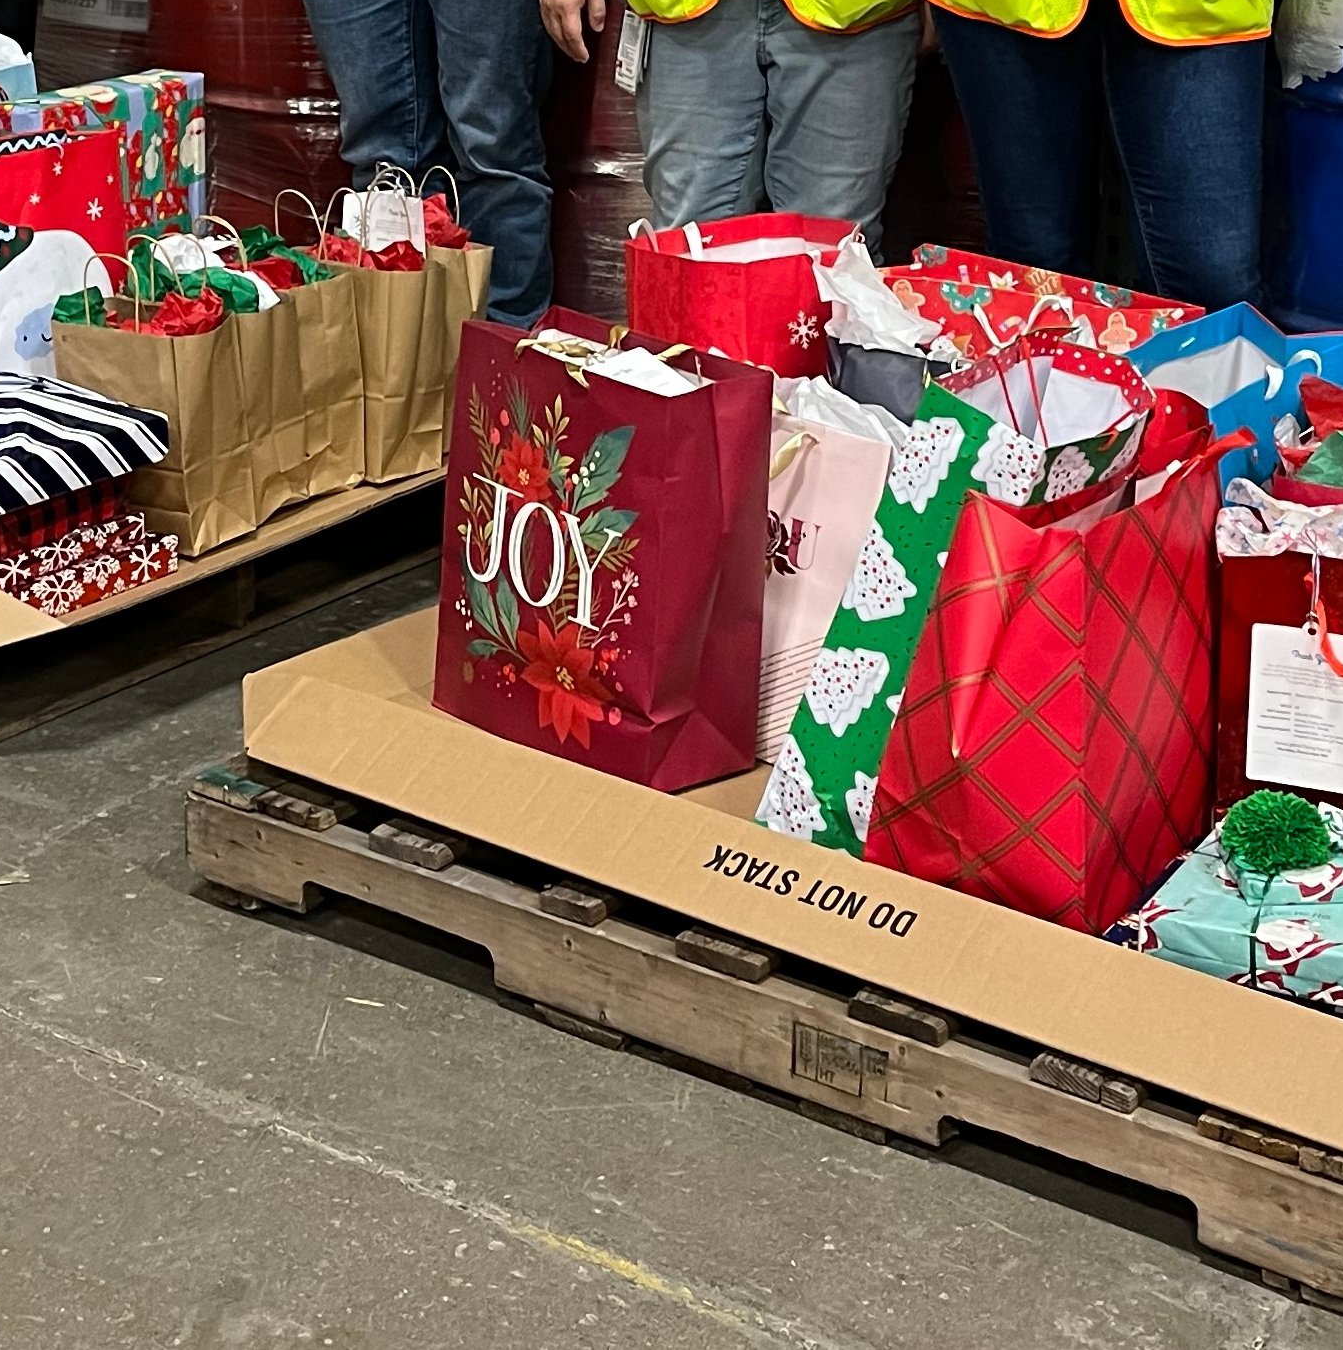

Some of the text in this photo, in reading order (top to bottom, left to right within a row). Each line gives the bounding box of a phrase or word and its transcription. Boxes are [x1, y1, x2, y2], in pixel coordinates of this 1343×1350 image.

[465, 472, 623, 632] JOY
[702, 844, 919, 938] DO NOT STACK
